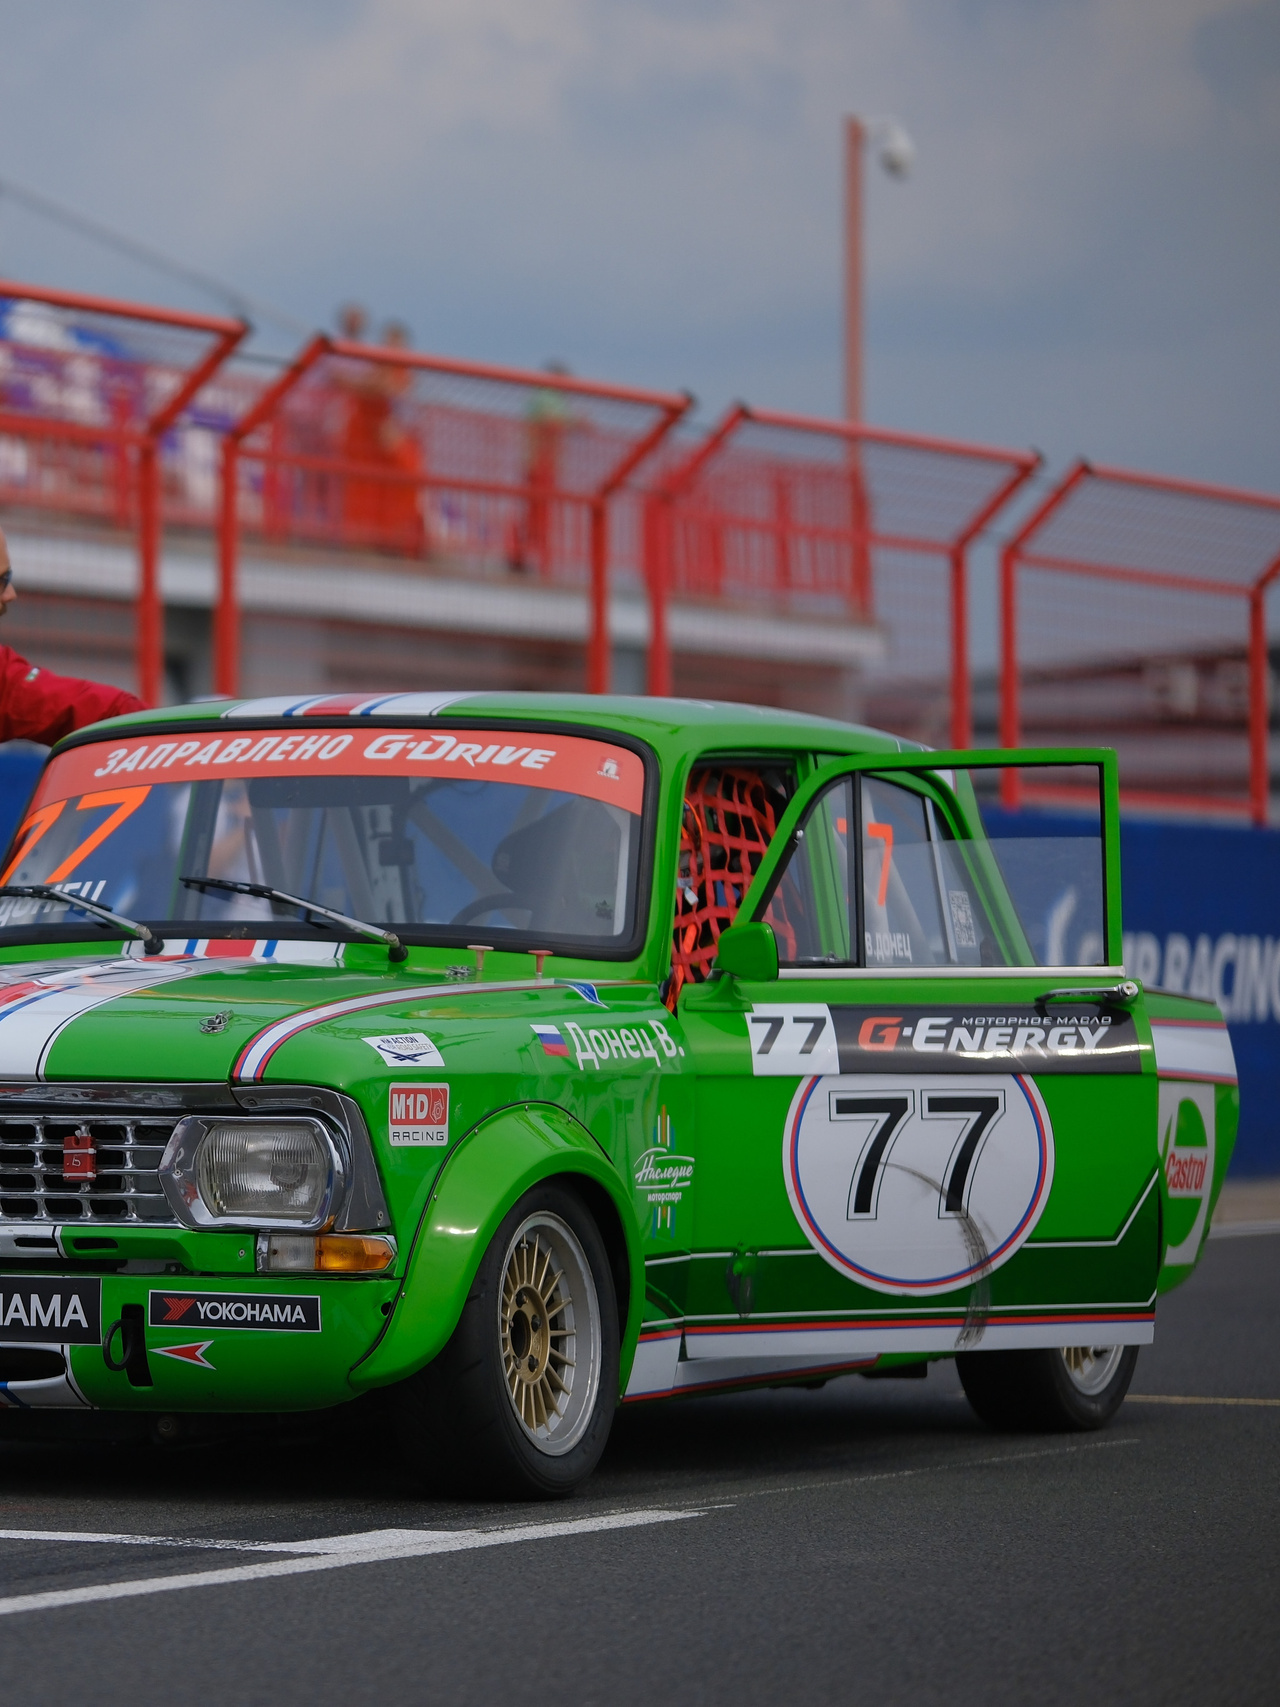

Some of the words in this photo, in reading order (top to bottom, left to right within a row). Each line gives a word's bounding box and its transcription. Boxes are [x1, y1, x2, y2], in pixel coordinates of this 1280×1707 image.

[94, 734, 354, 777] ЗАПРАВЛЕНО
[751, 1016, 827, 1054] 77
[961, 1016, 1052, 1026] МОТОРНОЕ
[1056, 1016, 1112, 1025] МАСЛО
[391, 1036, 419, 1044] ACTION
[564, 1021, 662, 1071] Донец
[648, 1019, 685, 1057] В.
[392, 1093, 429, 1120] M1D
[392, 1131, 445, 1141] RACING
[829, 1089, 1006, 1221] 77
[635, 1154, 693, 1188] Наследие
[1165, 1151, 1208, 1190] Castrol
[647, 1192, 682, 1204] моторспорт
[196, 1301, 307, 1323] YOKOHAMA
